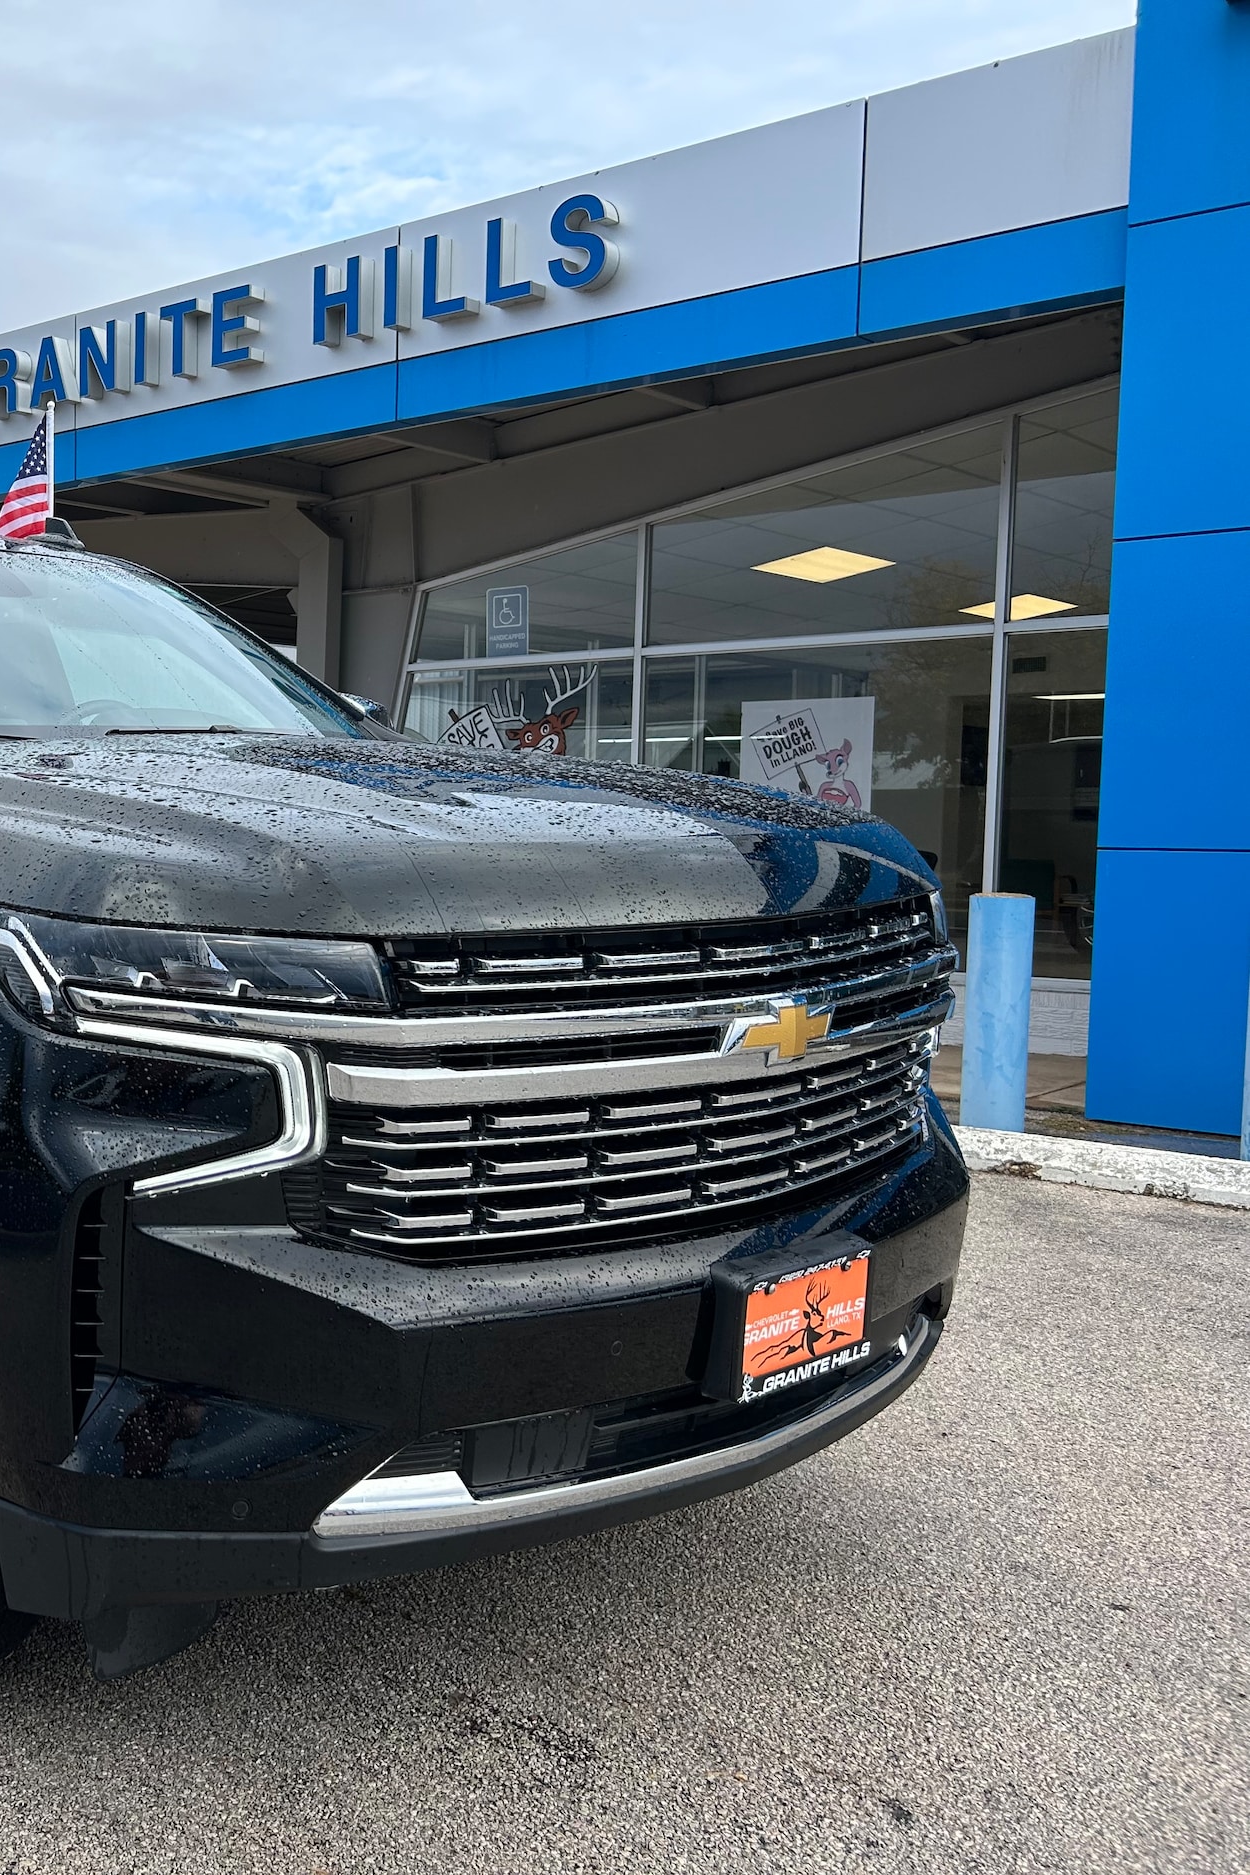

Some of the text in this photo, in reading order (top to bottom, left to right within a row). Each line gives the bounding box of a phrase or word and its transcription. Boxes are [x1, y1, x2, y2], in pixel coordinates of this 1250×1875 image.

[312, 194, 620, 348] HILLS
[490, 633, 525, 641] HANDICAPPED
[448, 712, 489, 747] SAVE
[788, 717, 804, 730] BIG
[762, 726, 812, 760] DOUGH
[780, 740, 817, 763] LLANO!
[744, 1297, 865, 1346] GRANITE HILLS
[753, 1310, 789, 1329] CHEVROLET
[852, 1311, 861, 1320] TX
[763, 1341, 870, 1393] GRANITE HILLS
